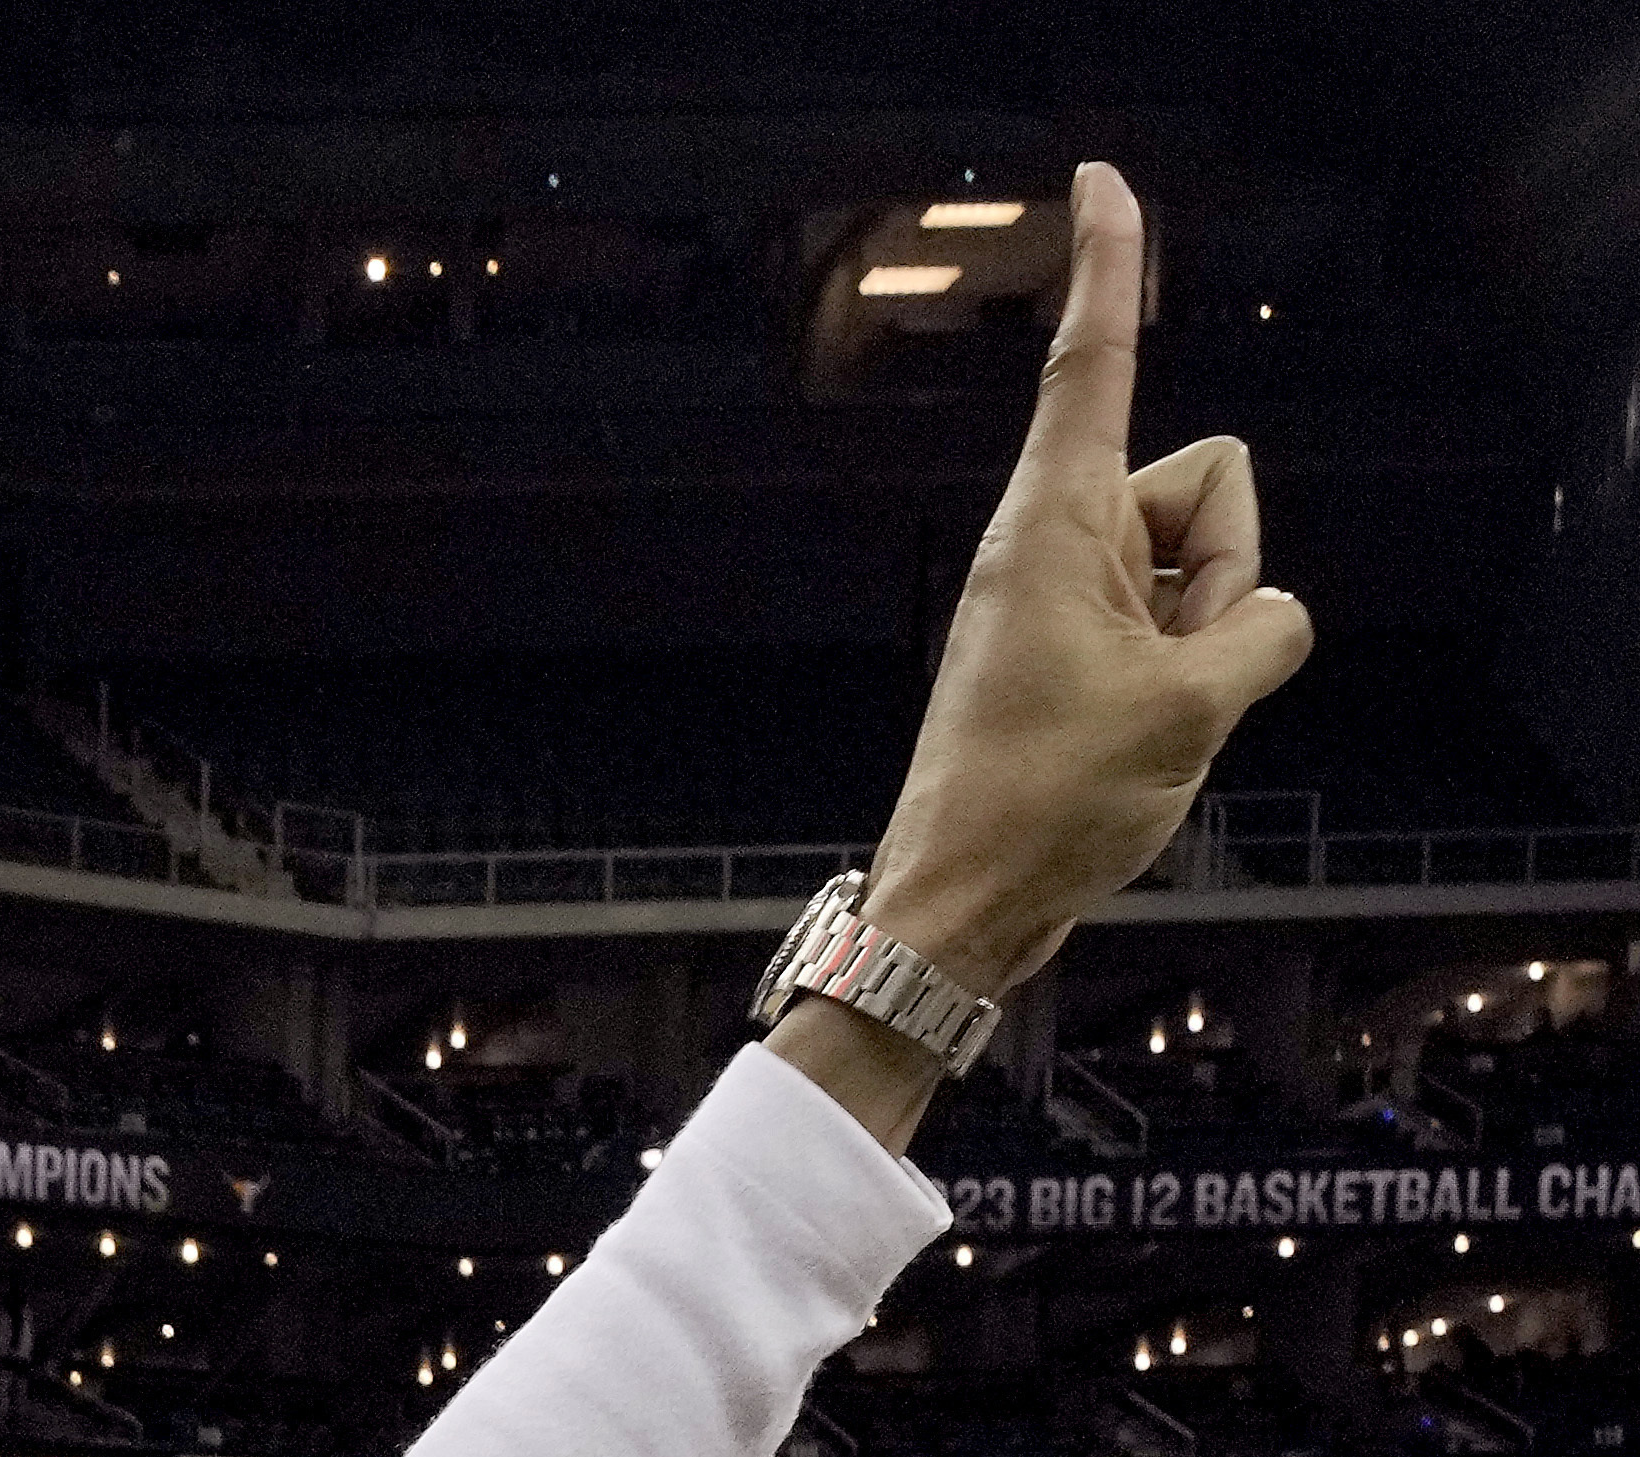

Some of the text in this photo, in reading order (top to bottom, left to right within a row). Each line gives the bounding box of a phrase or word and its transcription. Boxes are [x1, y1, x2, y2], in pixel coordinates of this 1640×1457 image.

[930, 1177, 1016, 1231] 23
[1030, 1174, 1115, 1226] BIG
[1132, 1172, 1181, 1226] 12
[1194, 1166, 1521, 1226] BASKETBALL
